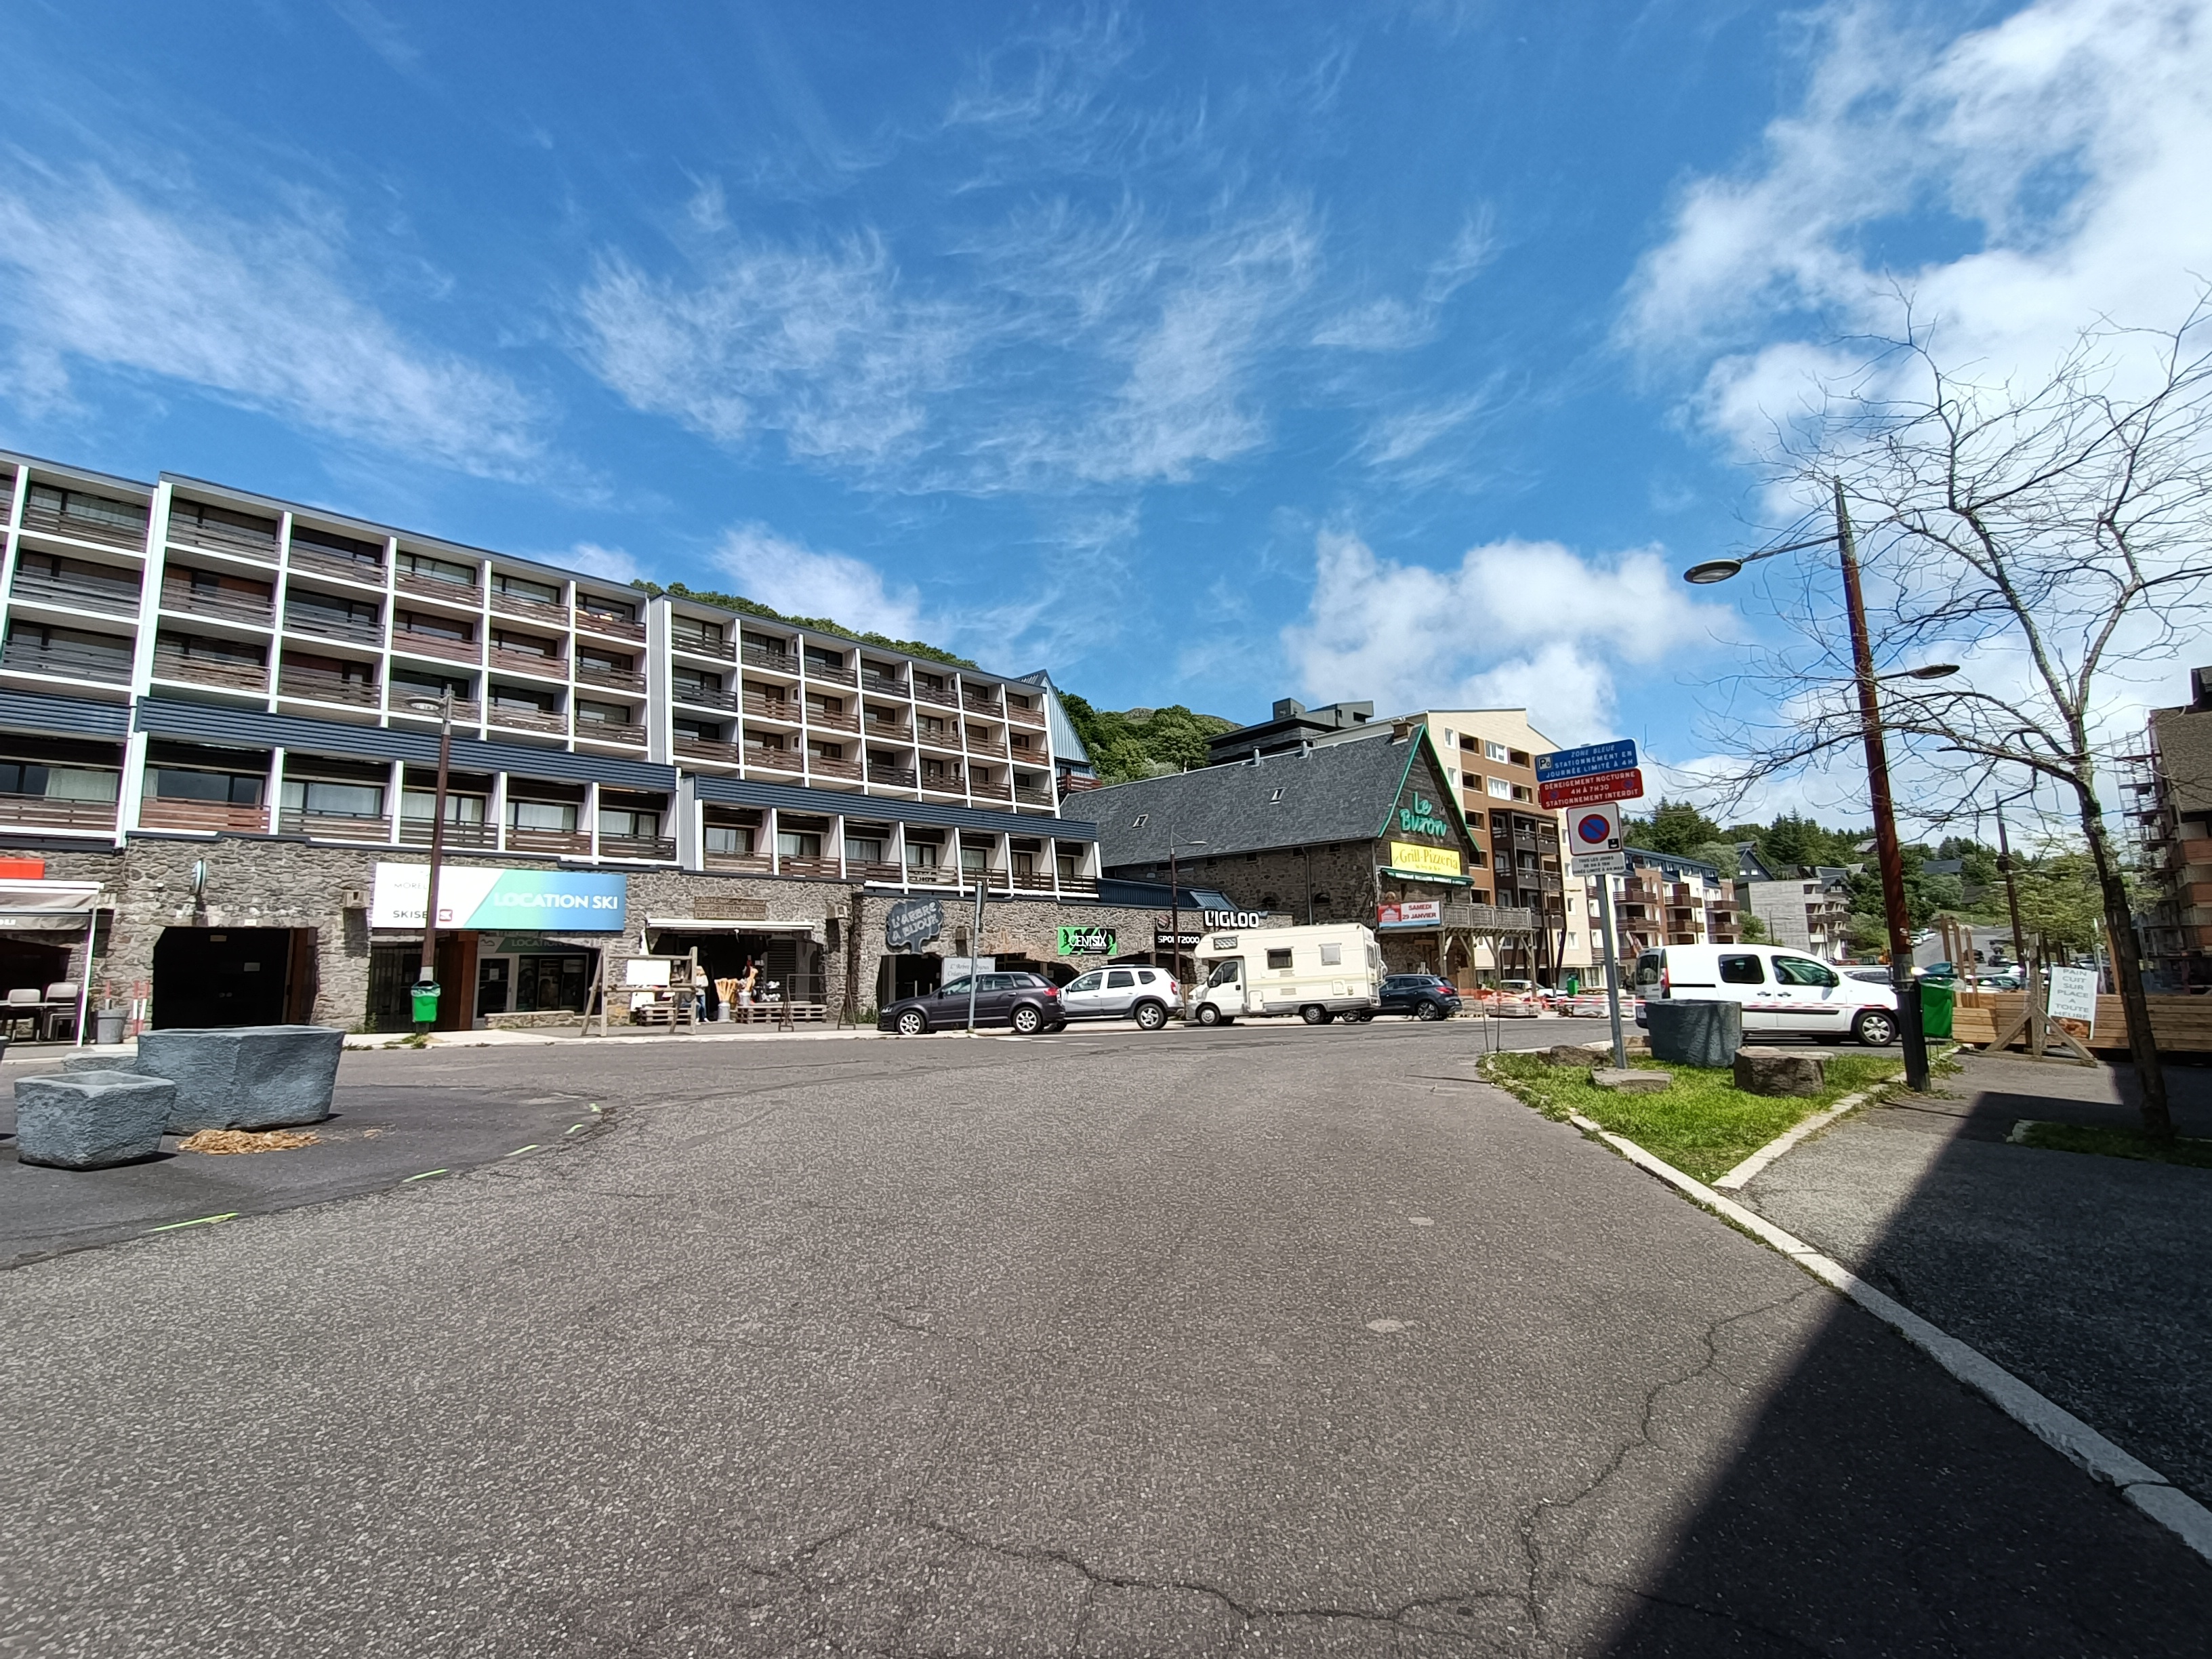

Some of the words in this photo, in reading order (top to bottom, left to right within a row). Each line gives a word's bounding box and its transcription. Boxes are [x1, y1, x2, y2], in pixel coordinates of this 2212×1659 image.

[1571, 749, 1589, 758] ZONE
[1593, 745, 1615, 754] BLEUE
[1555, 752, 1618, 769] STATIONNEMENT
[1546, 766, 1581, 779] JOURNÉE
[1584, 762, 1610, 772] LIMITÉ
[1544, 777, 1594, 790] DÉNEIGEMENT
[1596, 771, 1635, 783] NOCTURNE
[1589, 784, 1610, 792] 7H30
[1413, 791, 1433, 815] Le
[1545, 794, 1603, 808] STATIONNEMENT
[1605, 788, 1639, 799] INTERDIT
[494, 893, 588, 908] LOCATION
[592, 895, 617, 909] SKI
[891, 902, 937, 928] L'ARBRE
[1204, 910, 1260, 928] L'IGLOO
[902, 914, 939, 937] BIJOUX
[2057, 989, 2089, 998] PLACE
[2055, 1003, 2089, 1012] TOUTE
